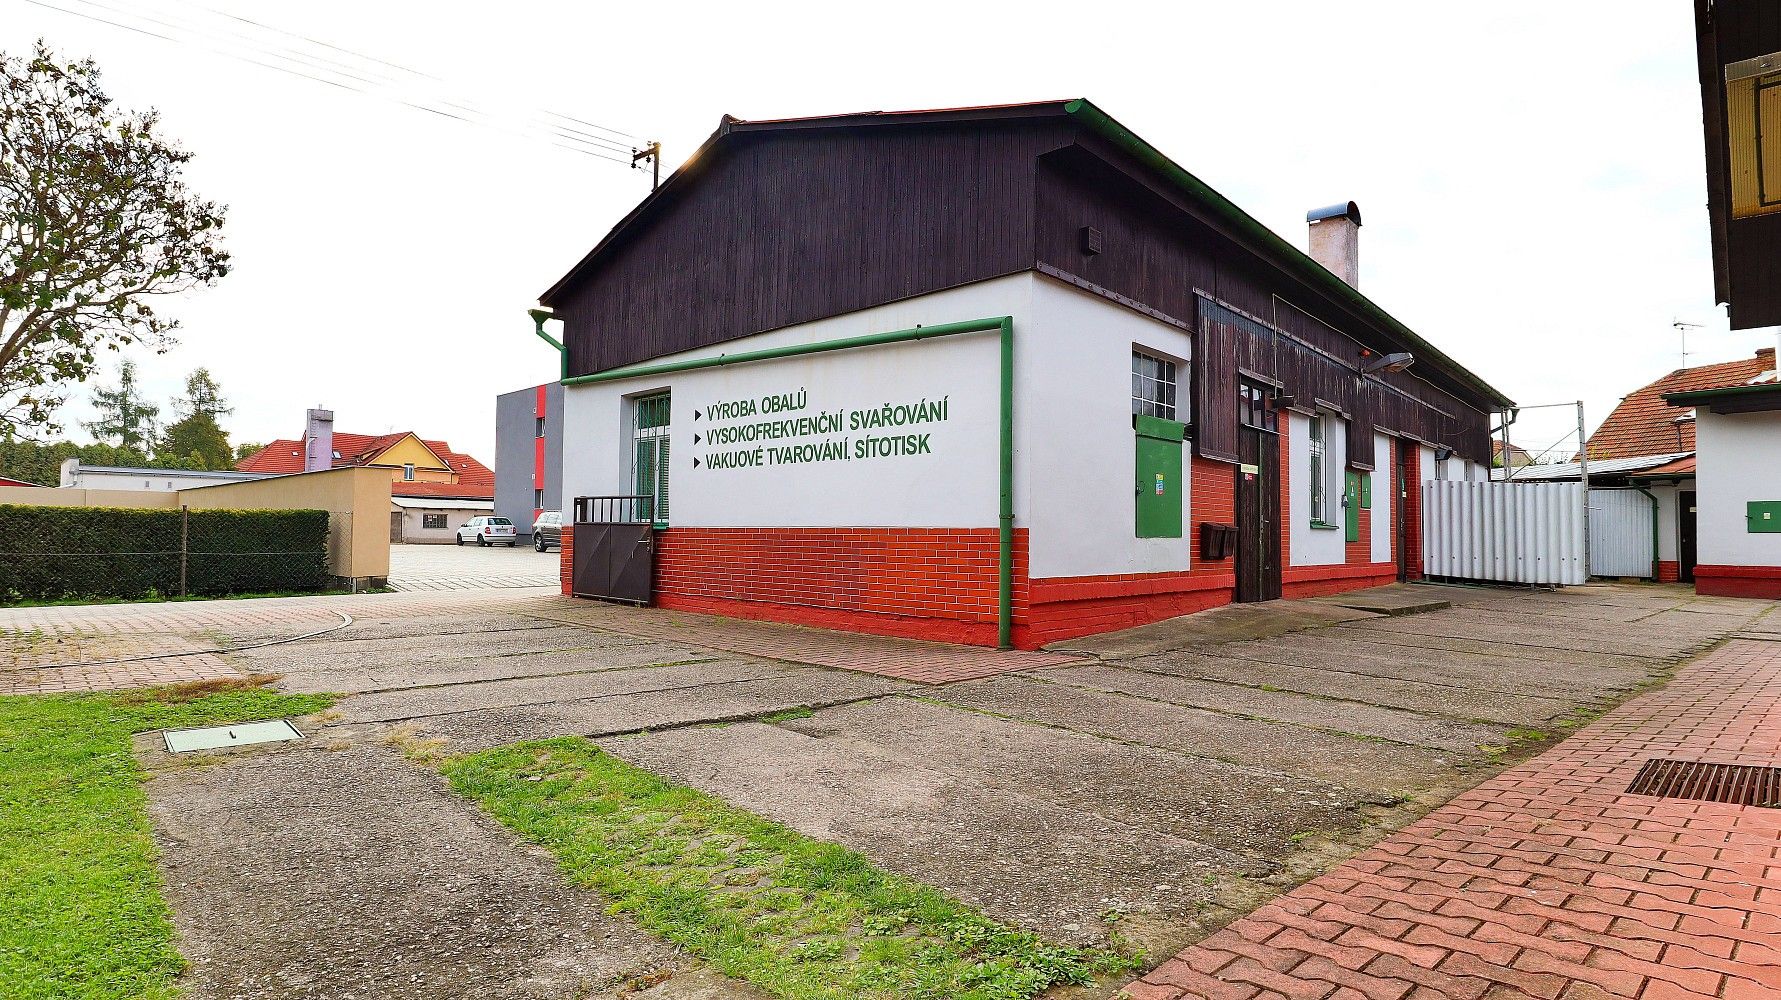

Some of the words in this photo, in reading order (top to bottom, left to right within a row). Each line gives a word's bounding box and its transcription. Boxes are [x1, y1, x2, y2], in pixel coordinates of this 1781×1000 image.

[706, 398, 757, 422] VÝROBA
[761, 386, 807, 415] OBALŮ
[706, 408, 844, 446] VYSOKOFREKVENČNÍ
[849, 394, 950, 431] SVAŘOVÁNÍ
[705, 444, 764, 470] VAKUOVÉ
[766, 436, 851, 466] TVAROVÁNÍ,
[854, 433, 932, 459] SÍTOTISK
